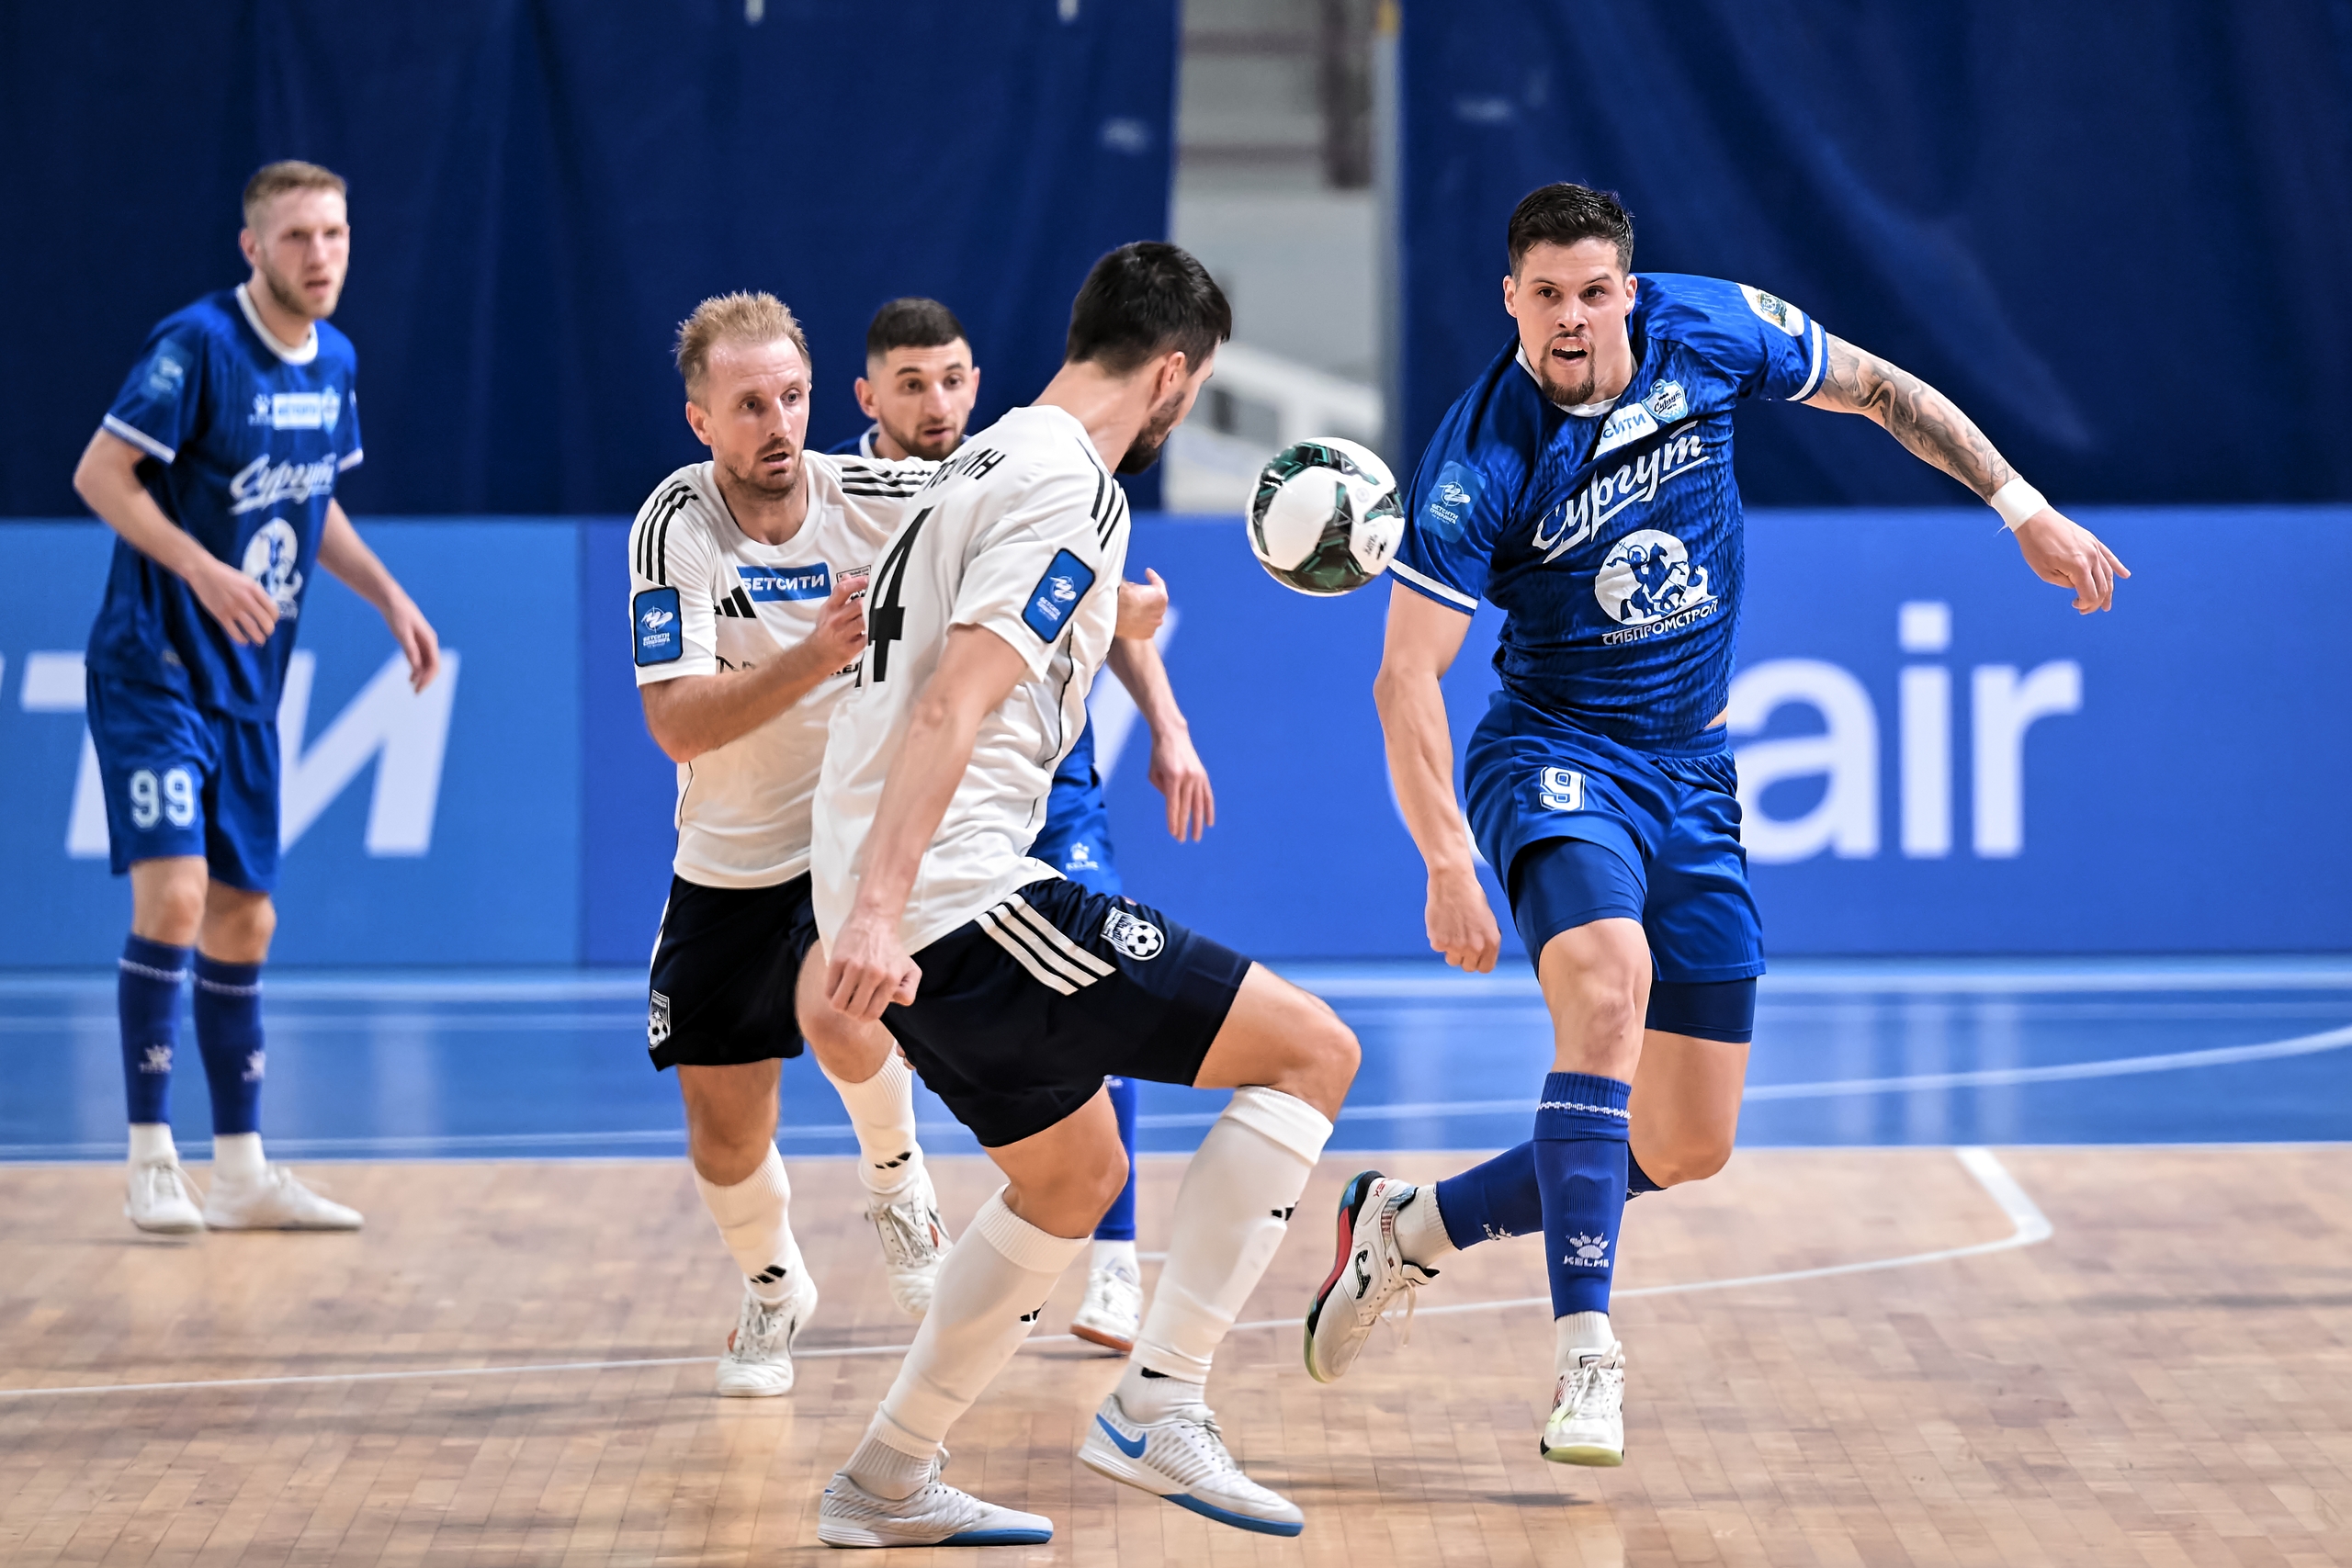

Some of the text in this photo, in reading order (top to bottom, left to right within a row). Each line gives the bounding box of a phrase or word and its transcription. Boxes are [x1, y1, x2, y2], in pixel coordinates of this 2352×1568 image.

[1532, 421, 1710, 564] Сургут
[742, 573, 825, 592] БЕТСИТИ
[855, 505, 935, 687] 4
[1602, 599, 1718, 646] СИБПРОМСТРОЙ
[0, 649, 460, 860] ТИ
[1726, 600, 2083, 865] air
[130, 766, 197, 829] 99
[1539, 766, 1586, 811] 9
[1563, 1255, 1610, 1268] KELME
